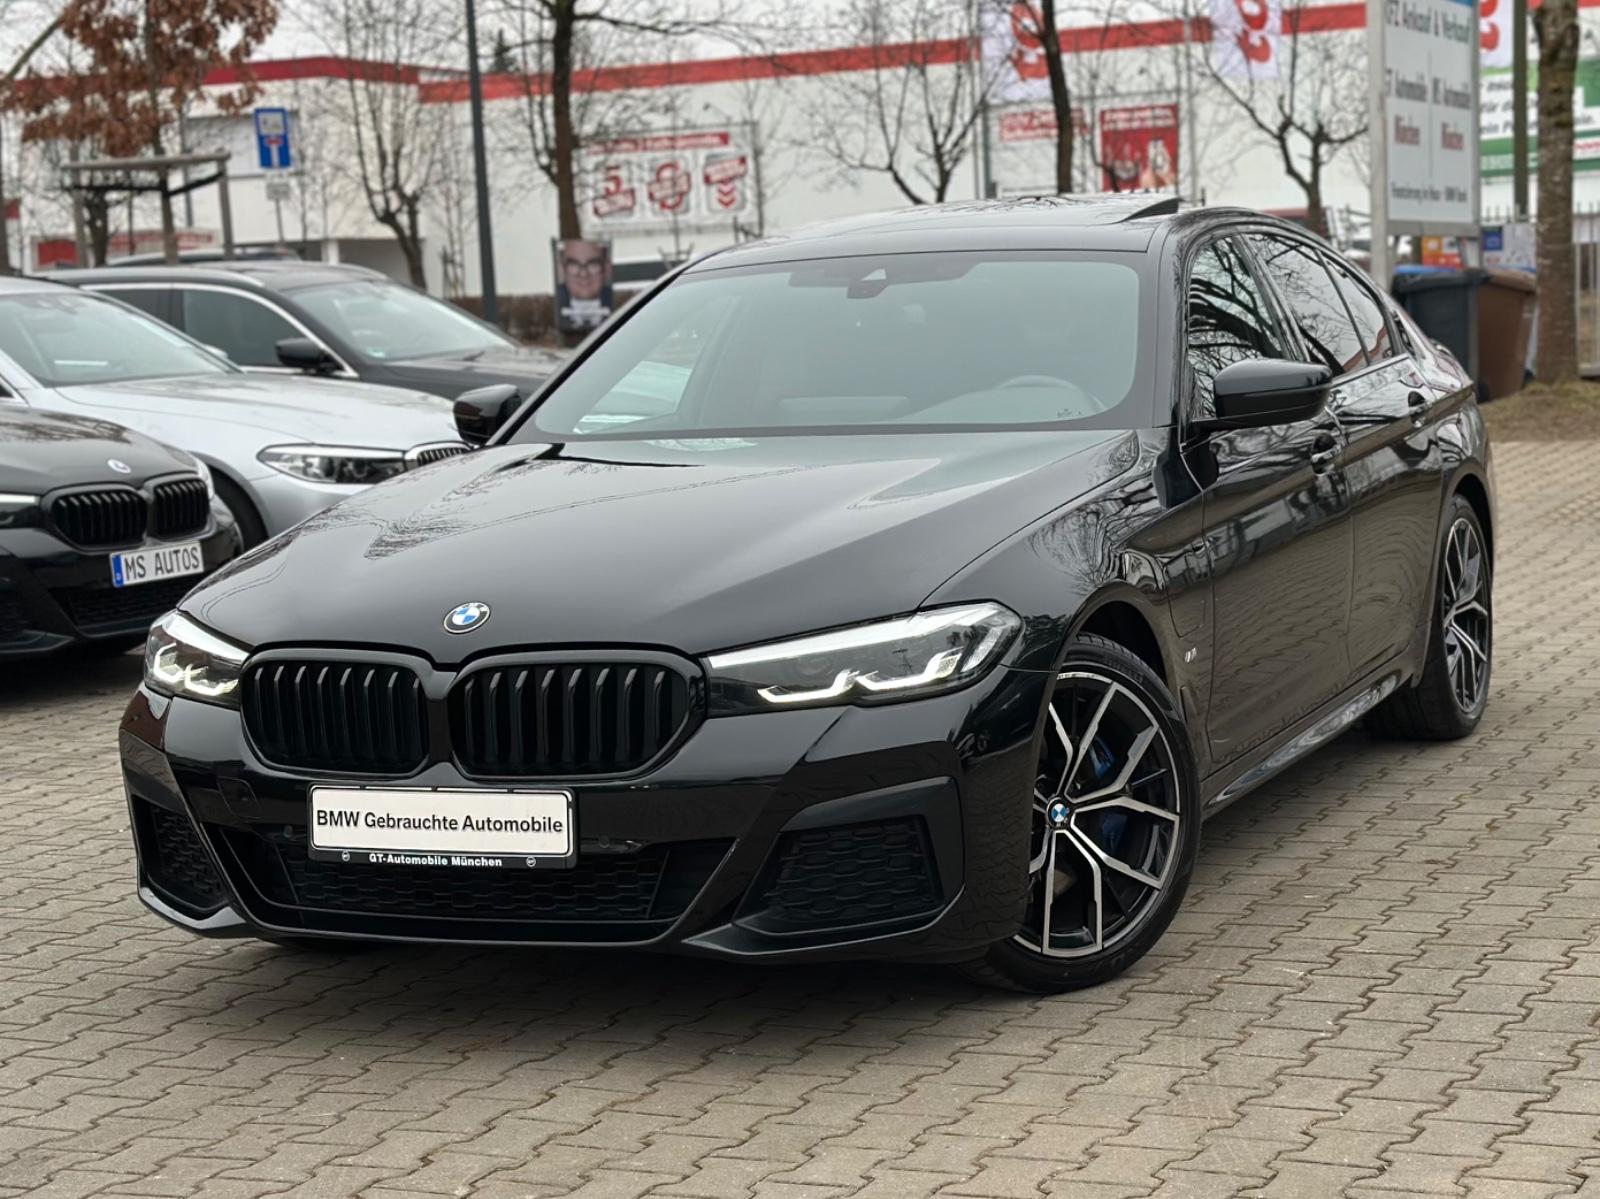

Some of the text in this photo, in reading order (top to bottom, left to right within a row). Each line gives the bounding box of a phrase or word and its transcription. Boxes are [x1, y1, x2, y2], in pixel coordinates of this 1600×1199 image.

[124, 546, 200, 580] MS AUTOS
[316, 810, 563, 833] BMW Gebrauchte Automobile
[369, 853, 503, 867] GT-Automobile München
